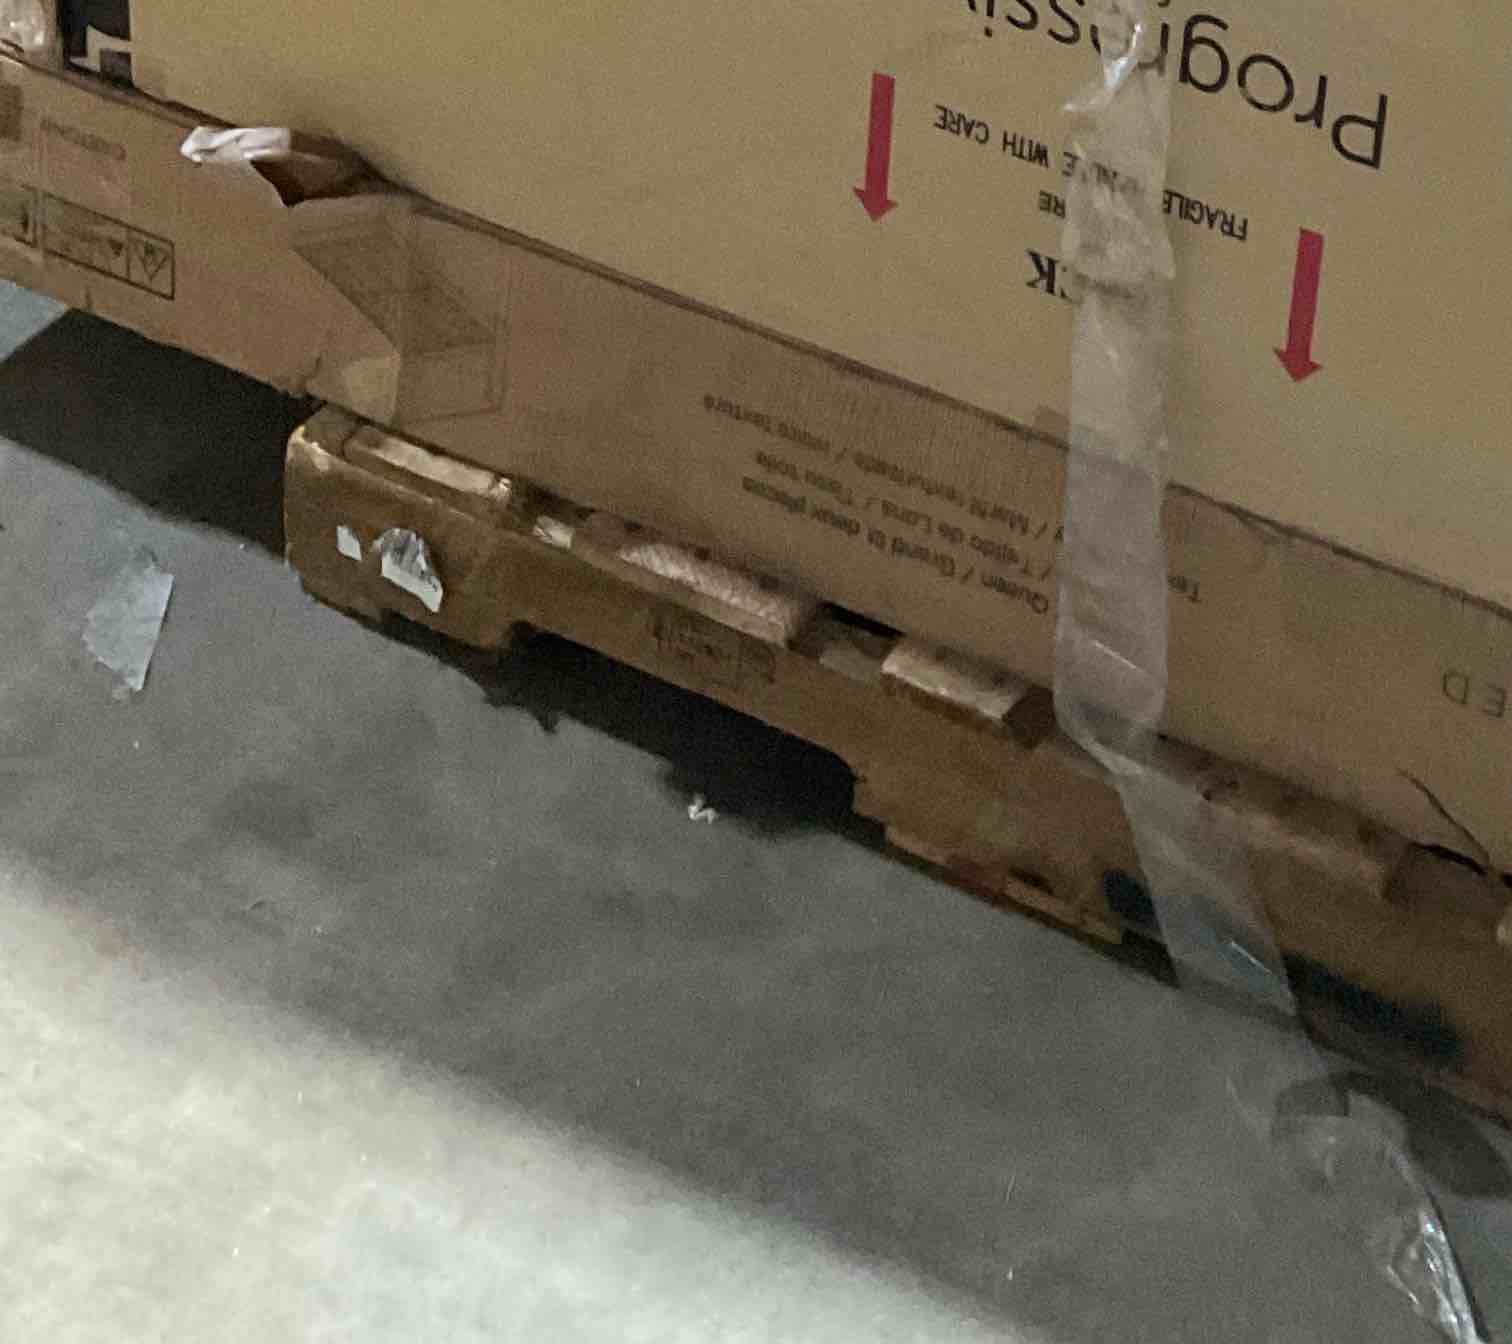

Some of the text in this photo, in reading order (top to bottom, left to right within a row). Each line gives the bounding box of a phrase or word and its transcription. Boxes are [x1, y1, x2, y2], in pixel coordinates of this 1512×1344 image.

[933, 104, 1049, 171] WITH CARE
[1162, 189, 1249, 242] FRAGILE
[981, 574, 1051, 616] Queen
